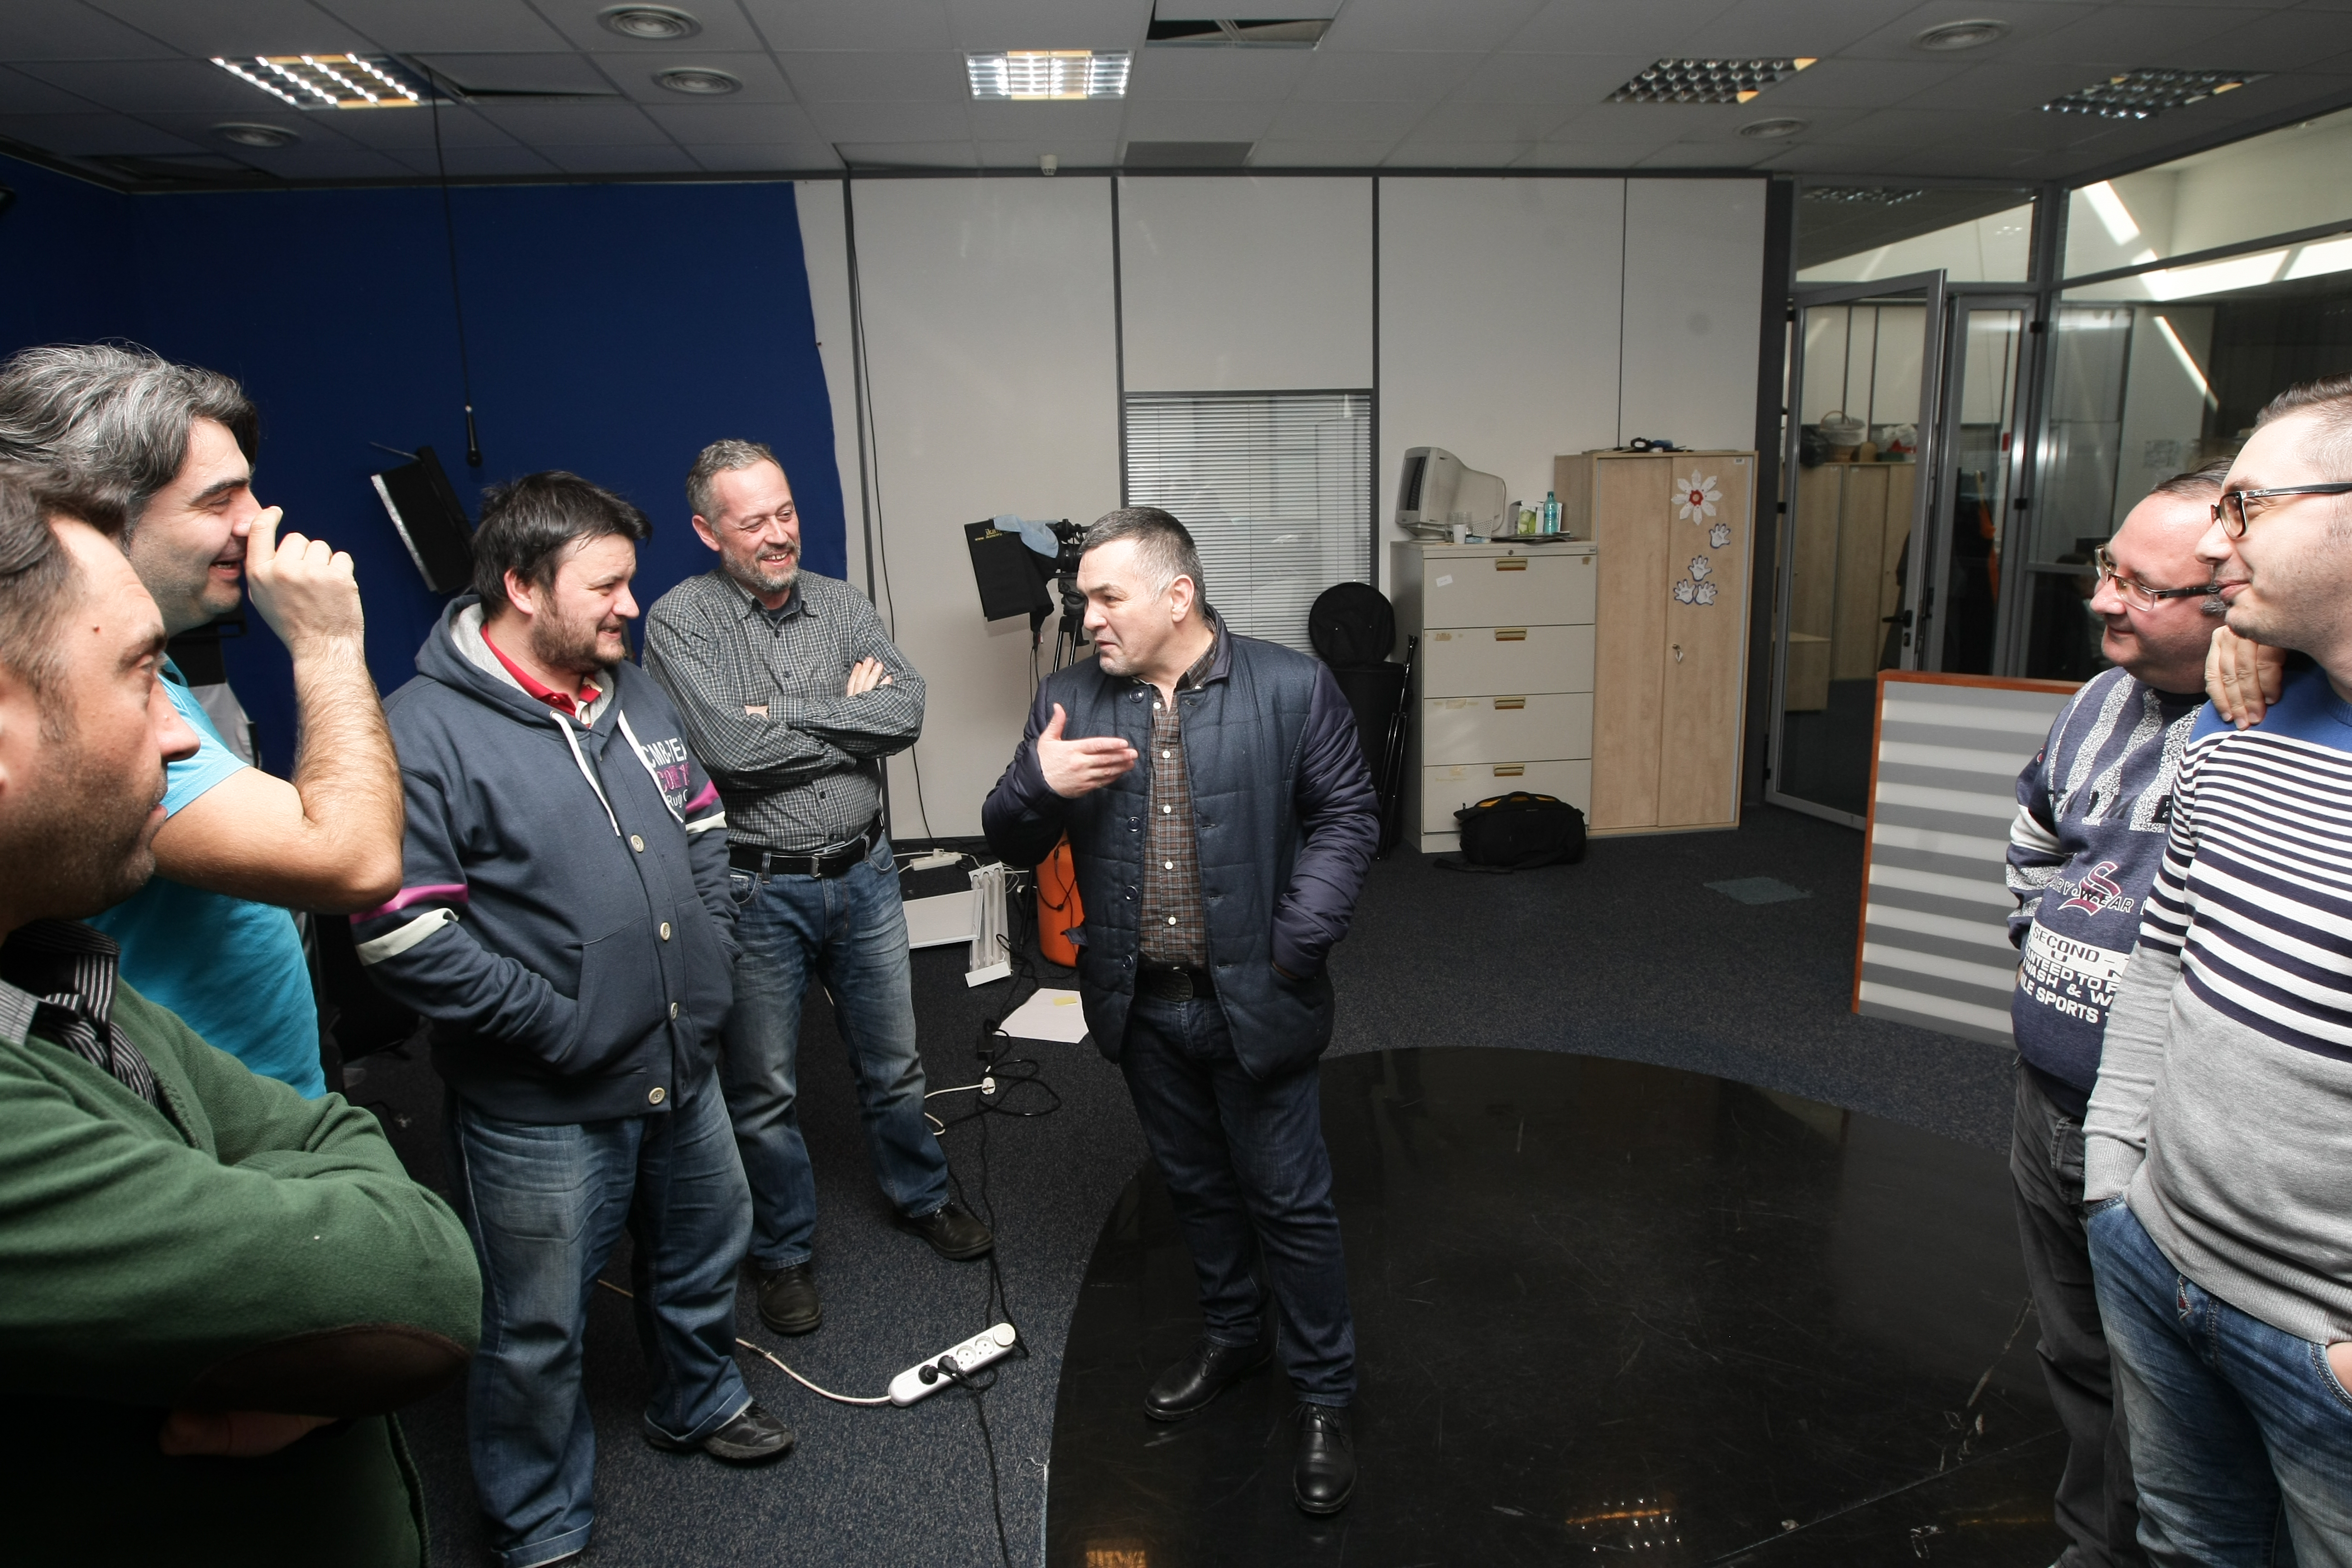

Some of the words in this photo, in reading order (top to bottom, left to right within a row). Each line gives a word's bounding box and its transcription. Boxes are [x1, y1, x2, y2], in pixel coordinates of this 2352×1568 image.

[2033, 926, 2100, 963] SECOND
[2077, 973, 2102, 990] TO
[2036, 986, 2099, 1024] SPORTS
